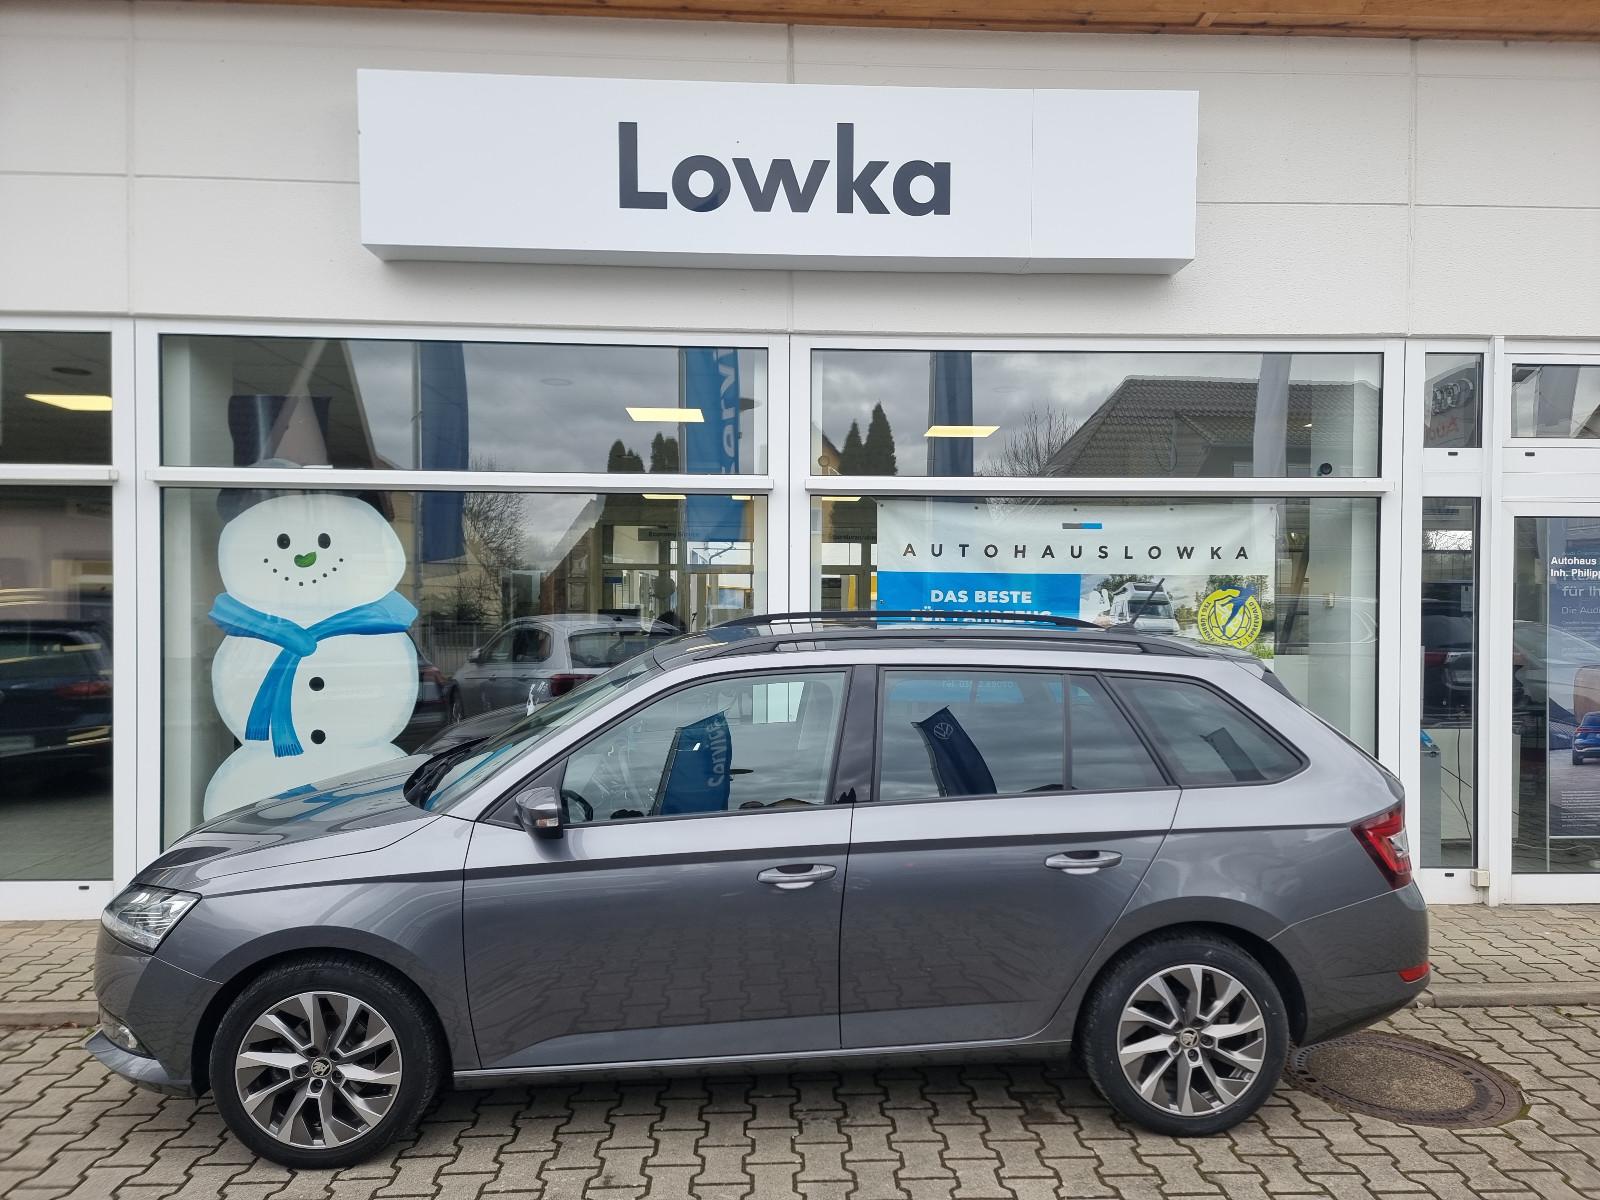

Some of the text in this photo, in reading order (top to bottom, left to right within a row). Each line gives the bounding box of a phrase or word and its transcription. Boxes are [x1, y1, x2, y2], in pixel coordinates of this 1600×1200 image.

[618, 121, 951, 217] Lowka
[1550, 556, 1597, 565] Autohaus
[1550, 568, 1569, 577] Inh.
[1571, 568, 1600, 580] Philip
[930, 589, 1032, 604] DAS BESTE
[1562, 586, 1584, 597] für
